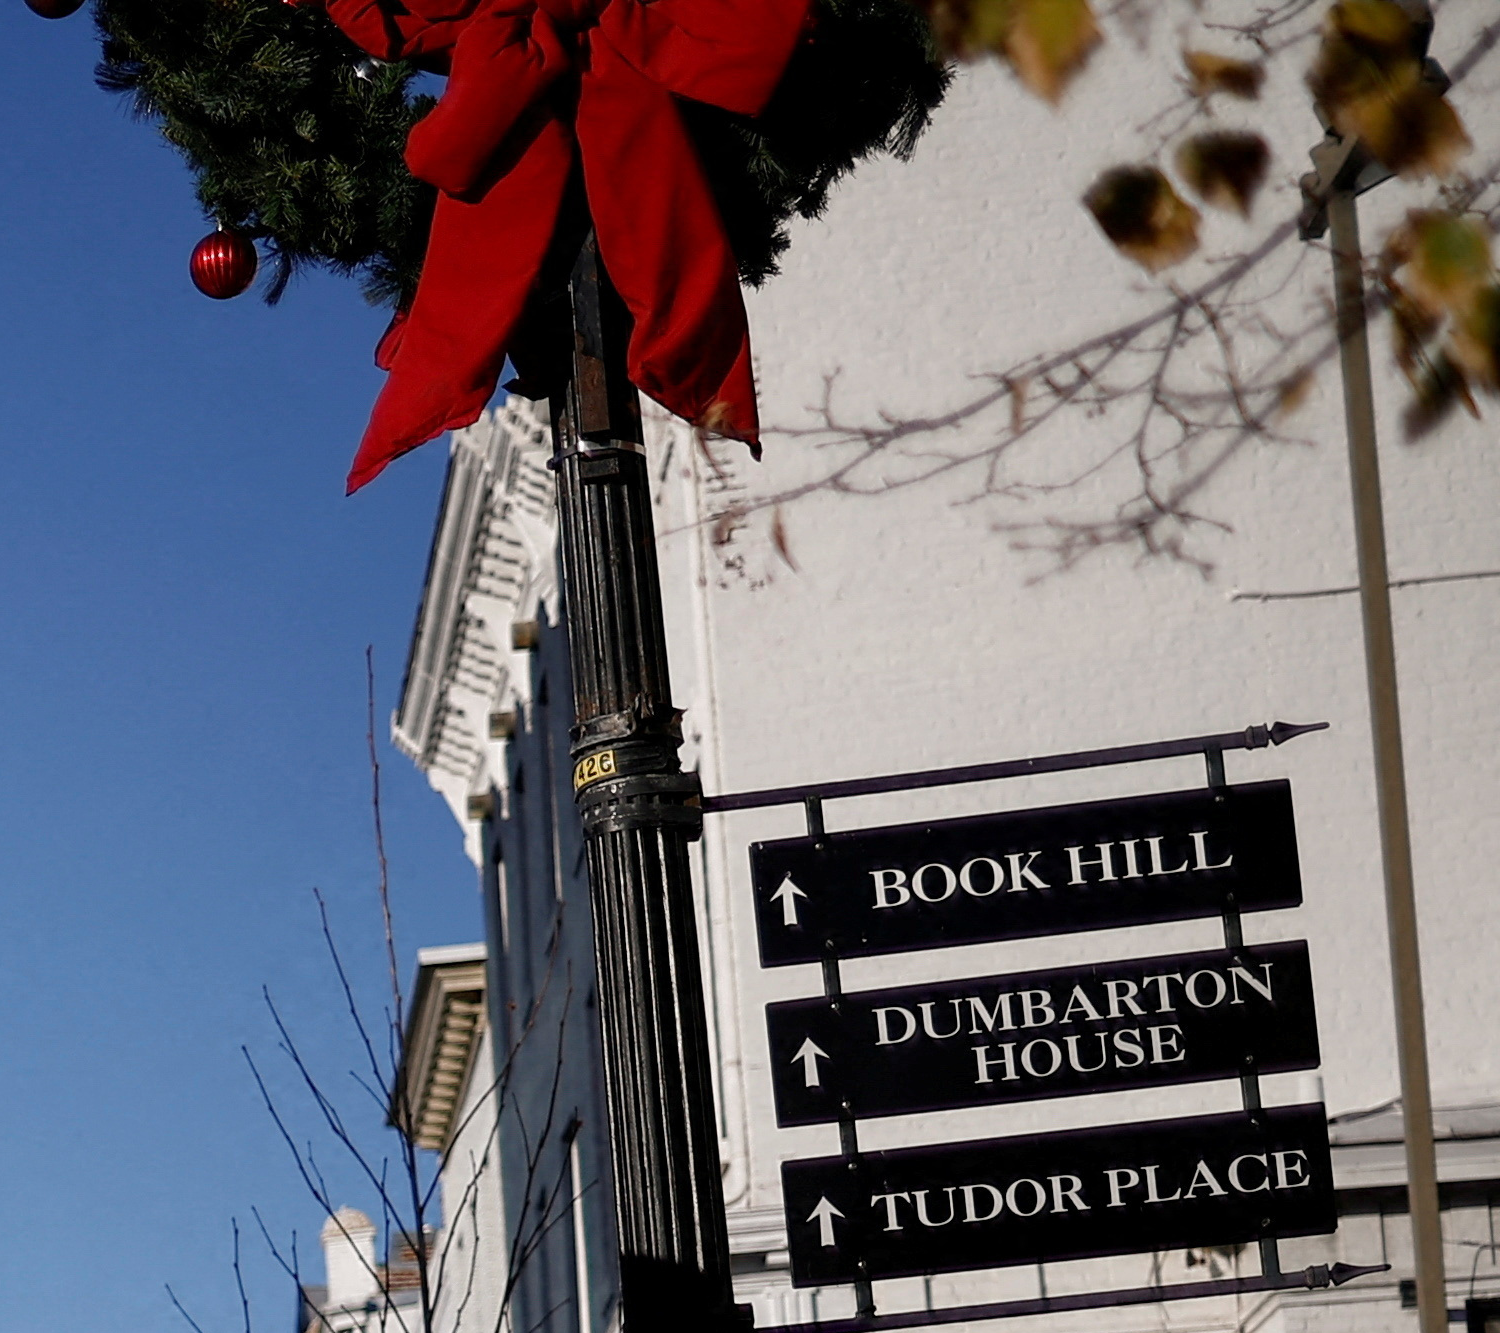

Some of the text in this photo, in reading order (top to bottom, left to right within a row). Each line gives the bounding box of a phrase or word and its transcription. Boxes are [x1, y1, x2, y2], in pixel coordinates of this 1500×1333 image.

[868, 829, 1234, 911] BOOK HILL
[873, 962, 1275, 1048] DUMBARTON
[973, 1024, 1188, 1085] HOUSE
[870, 1150, 1313, 1233] TUDOR PLACE
